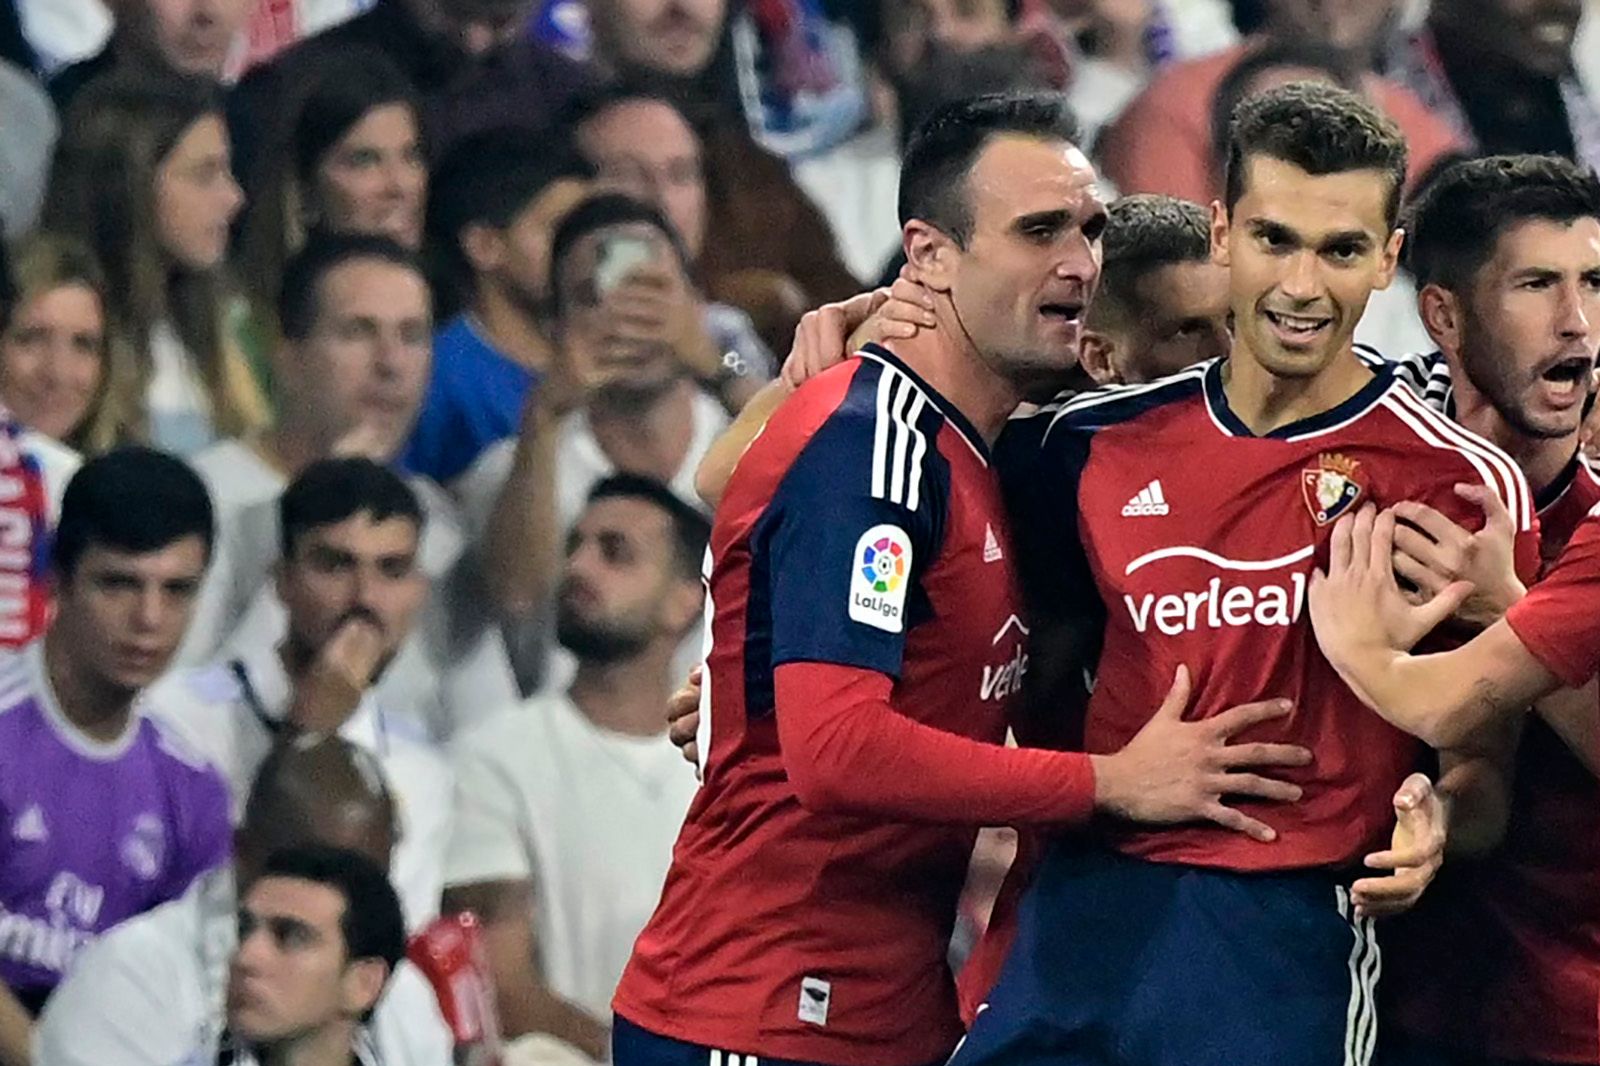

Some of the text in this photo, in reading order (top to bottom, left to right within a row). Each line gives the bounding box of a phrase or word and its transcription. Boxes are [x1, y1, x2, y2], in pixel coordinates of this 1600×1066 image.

[1121, 503, 1169, 517] adidas
[855, 592, 899, 618] LaLiga
[1124, 572, 1306, 636] verleal
